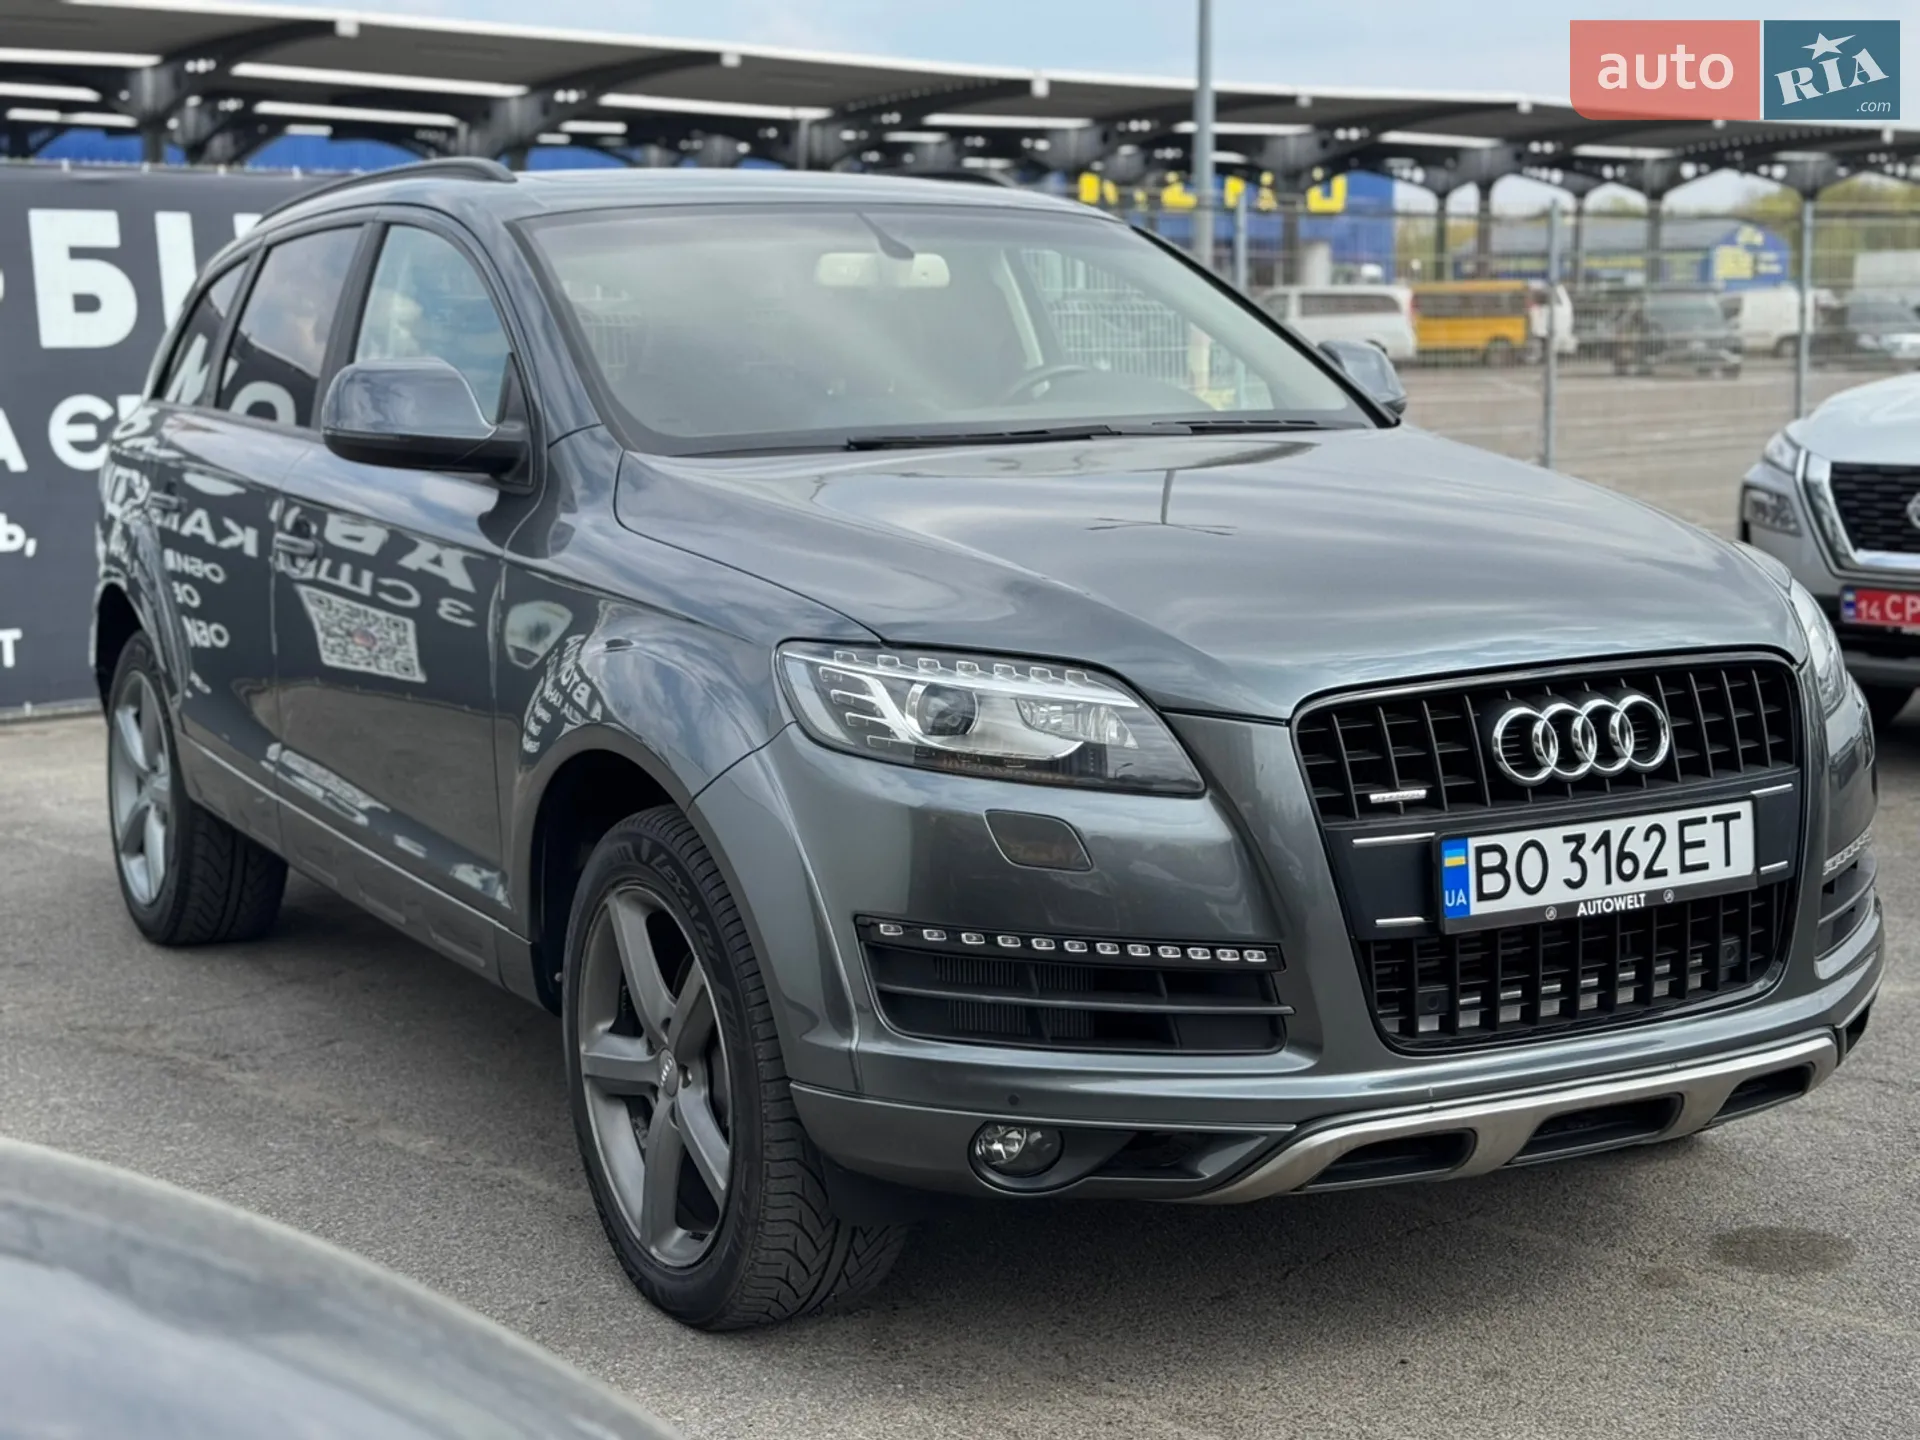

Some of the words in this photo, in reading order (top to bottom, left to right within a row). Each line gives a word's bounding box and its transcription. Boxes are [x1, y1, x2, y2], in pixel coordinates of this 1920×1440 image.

[1858, 600, 1881, 621] 14
[1444, 888, 1468, 907] UA
[1474, 838, 1549, 903] BO
[1562, 822, 1669, 890] 3162
[1677, 810, 1742, 875] ET
[1576, 893, 1647, 917] AUTOWELT
